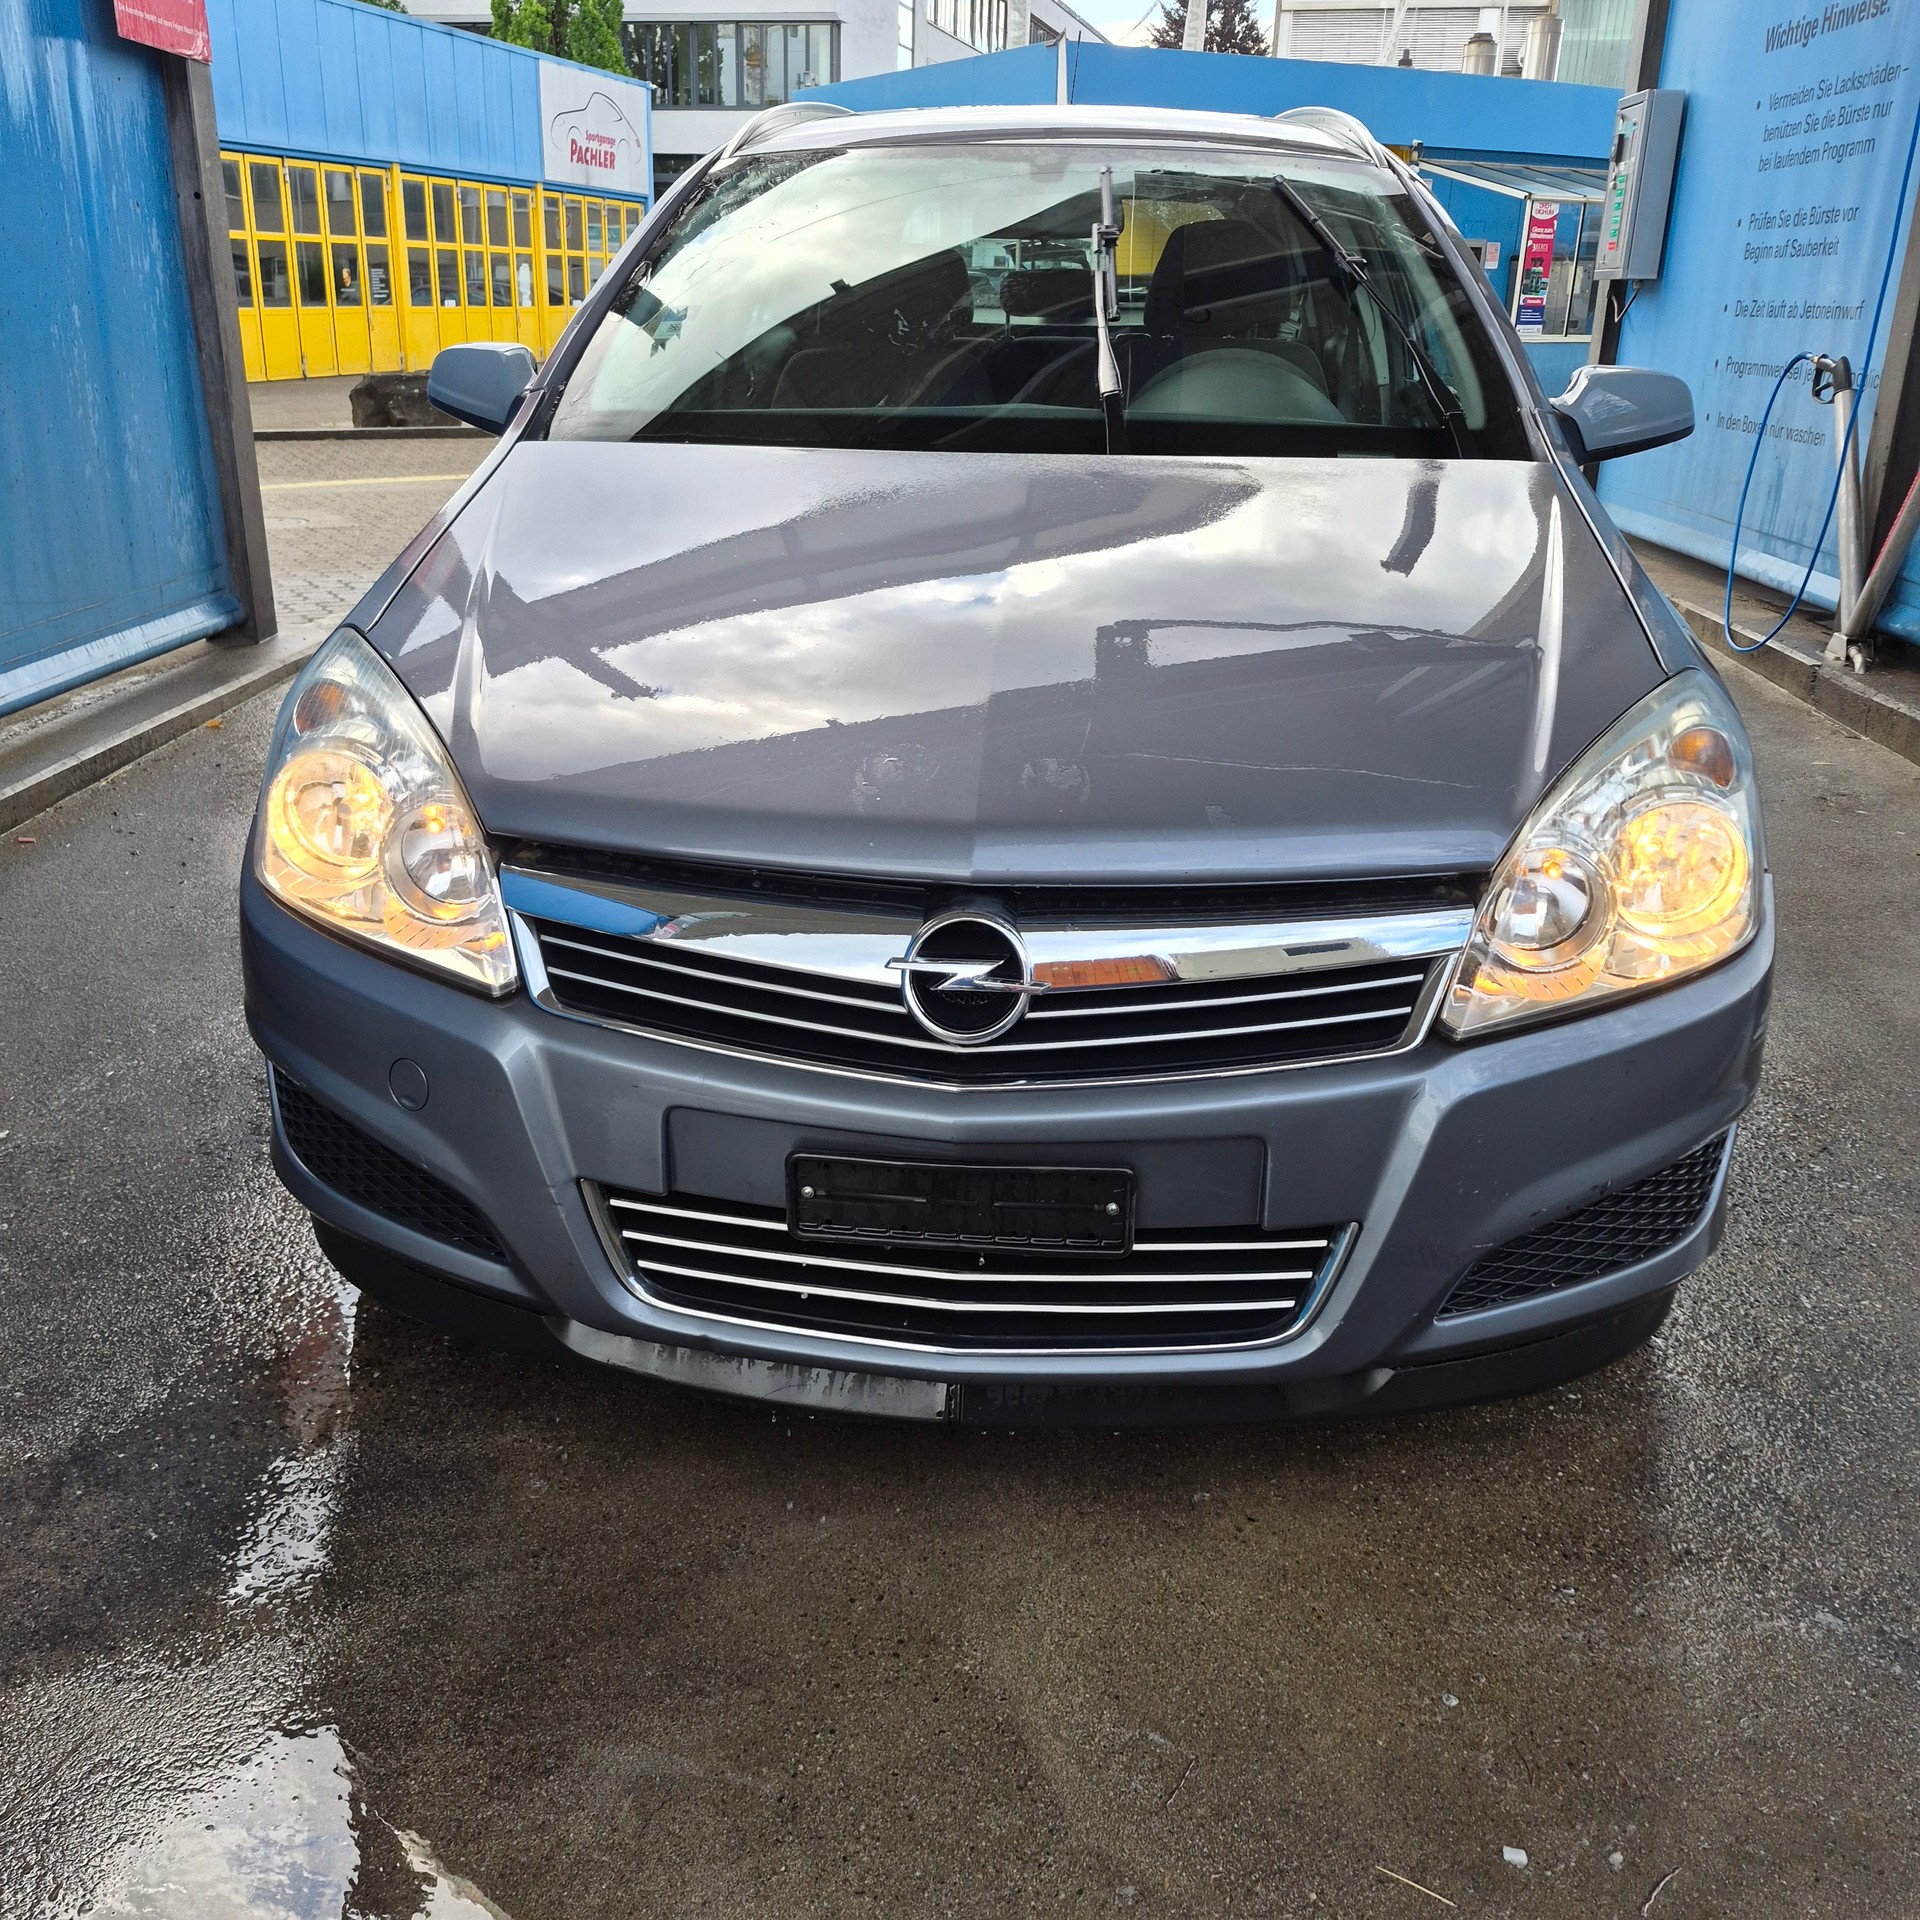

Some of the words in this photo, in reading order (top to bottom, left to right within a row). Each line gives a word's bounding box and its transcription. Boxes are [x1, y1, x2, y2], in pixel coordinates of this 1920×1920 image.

[1765, 15, 1819, 53] Wichtige
[1769, 85, 1815, 111] Vermeiden
[1817, 78, 1832, 100] Sie
[1763, 120, 1802, 142] benützen
[1804, 113, 1820, 134] Sie
[1821, 109, 1836, 130] die
[1837, 104, 1871, 126] Bürste
[1872, 100, 1894, 119] nur
[570, 138, 616, 170] PACHLER
[586, 130, 616, 148] Sportgarage
[1758, 153, 1771, 172] bei
[1773, 146, 1821, 170] laufendem
[1821, 138, 1876, 163] Programm
[1748, 211, 1777, 231] Prüfen
[1778, 209, 1791, 229] Sie
[1793, 207, 1808, 227] die
[1809, 205, 1840, 226] Bürste
[1842, 206, 1860, 222] vor
[1744, 241, 1774, 264] Beginn
[1774, 239, 1790, 258] auf
[1790, 236, 1840, 258] Sauberkeit
[1735, 300, 1748, 318] Die
[1749, 300, 1766, 318] Zeit
[1767, 300, 1787, 319] läuft
[1787, 300, 1799, 319] ab
[1800, 300, 1865, 320] Jetoneinwurf
[1717, 411, 1725, 429] In
[1726, 413, 1741, 431] den
[1769, 422, 1784, 439] nur
[1786, 426, 1826, 447] waschen
